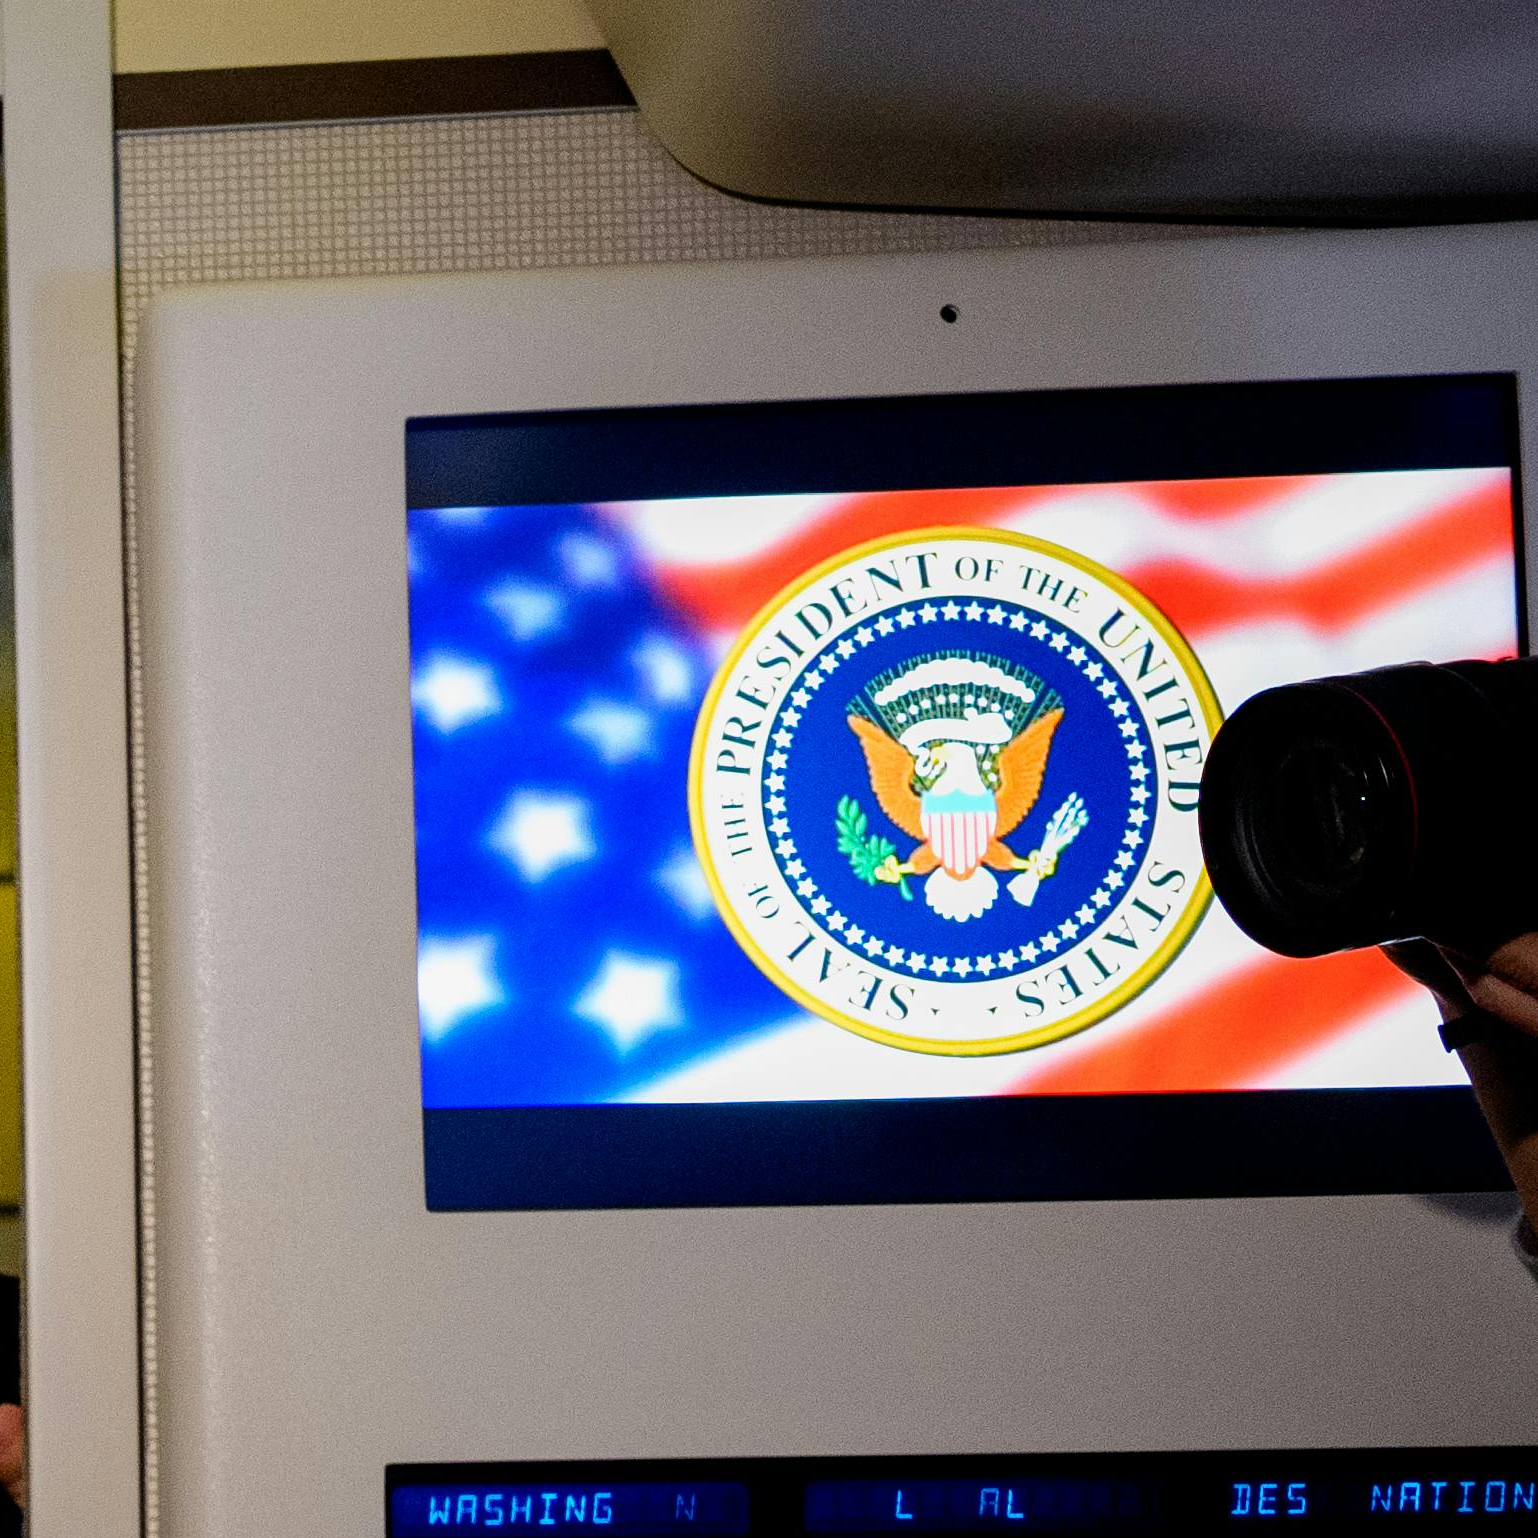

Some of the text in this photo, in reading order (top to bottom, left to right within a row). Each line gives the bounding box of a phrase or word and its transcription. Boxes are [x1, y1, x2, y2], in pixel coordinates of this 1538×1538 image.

[715, 552, 1203, 1020] SEAL OF THE PRESIDENT OF THE UNITED STATES
